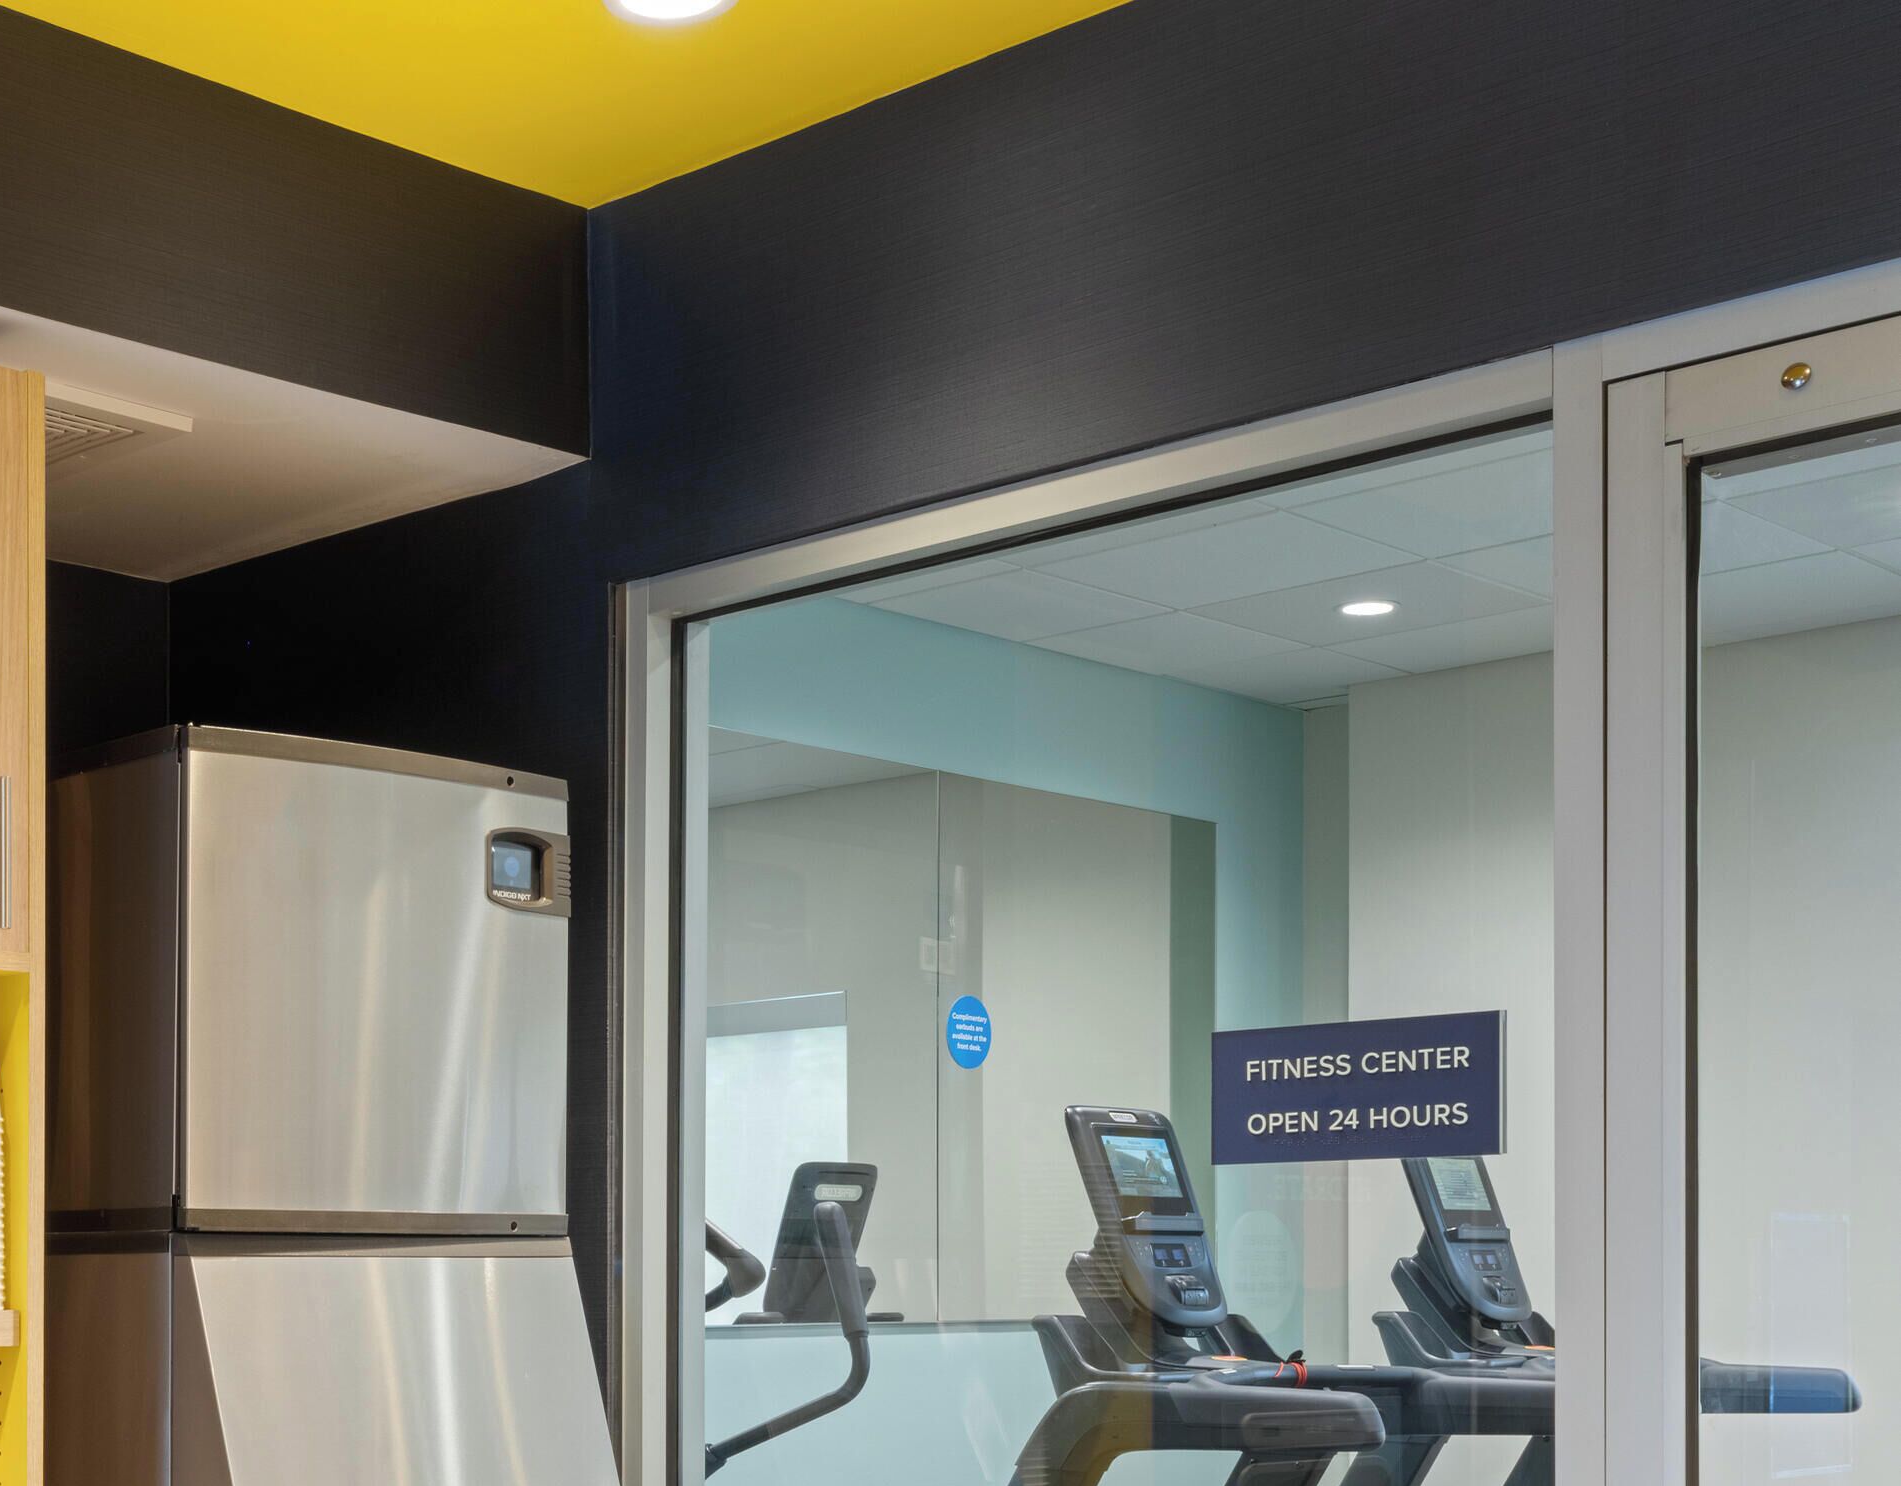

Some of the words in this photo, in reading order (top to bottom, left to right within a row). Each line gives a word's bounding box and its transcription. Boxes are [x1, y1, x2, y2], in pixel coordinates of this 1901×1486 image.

[518, 893, 532, 901] NXT
[951, 1012, 987, 1024] Complimentary
[952, 1033, 973, 1041] available
[957, 1042, 969, 1050] front
[1245, 1054, 1351, 1082] FITNESS
[1361, 1046, 1470, 1075] CENTER
[1247, 1110, 1319, 1135] OPEN
[1328, 1108, 1360, 1131] 24
[1369, 1102, 1469, 1129] HOURS
